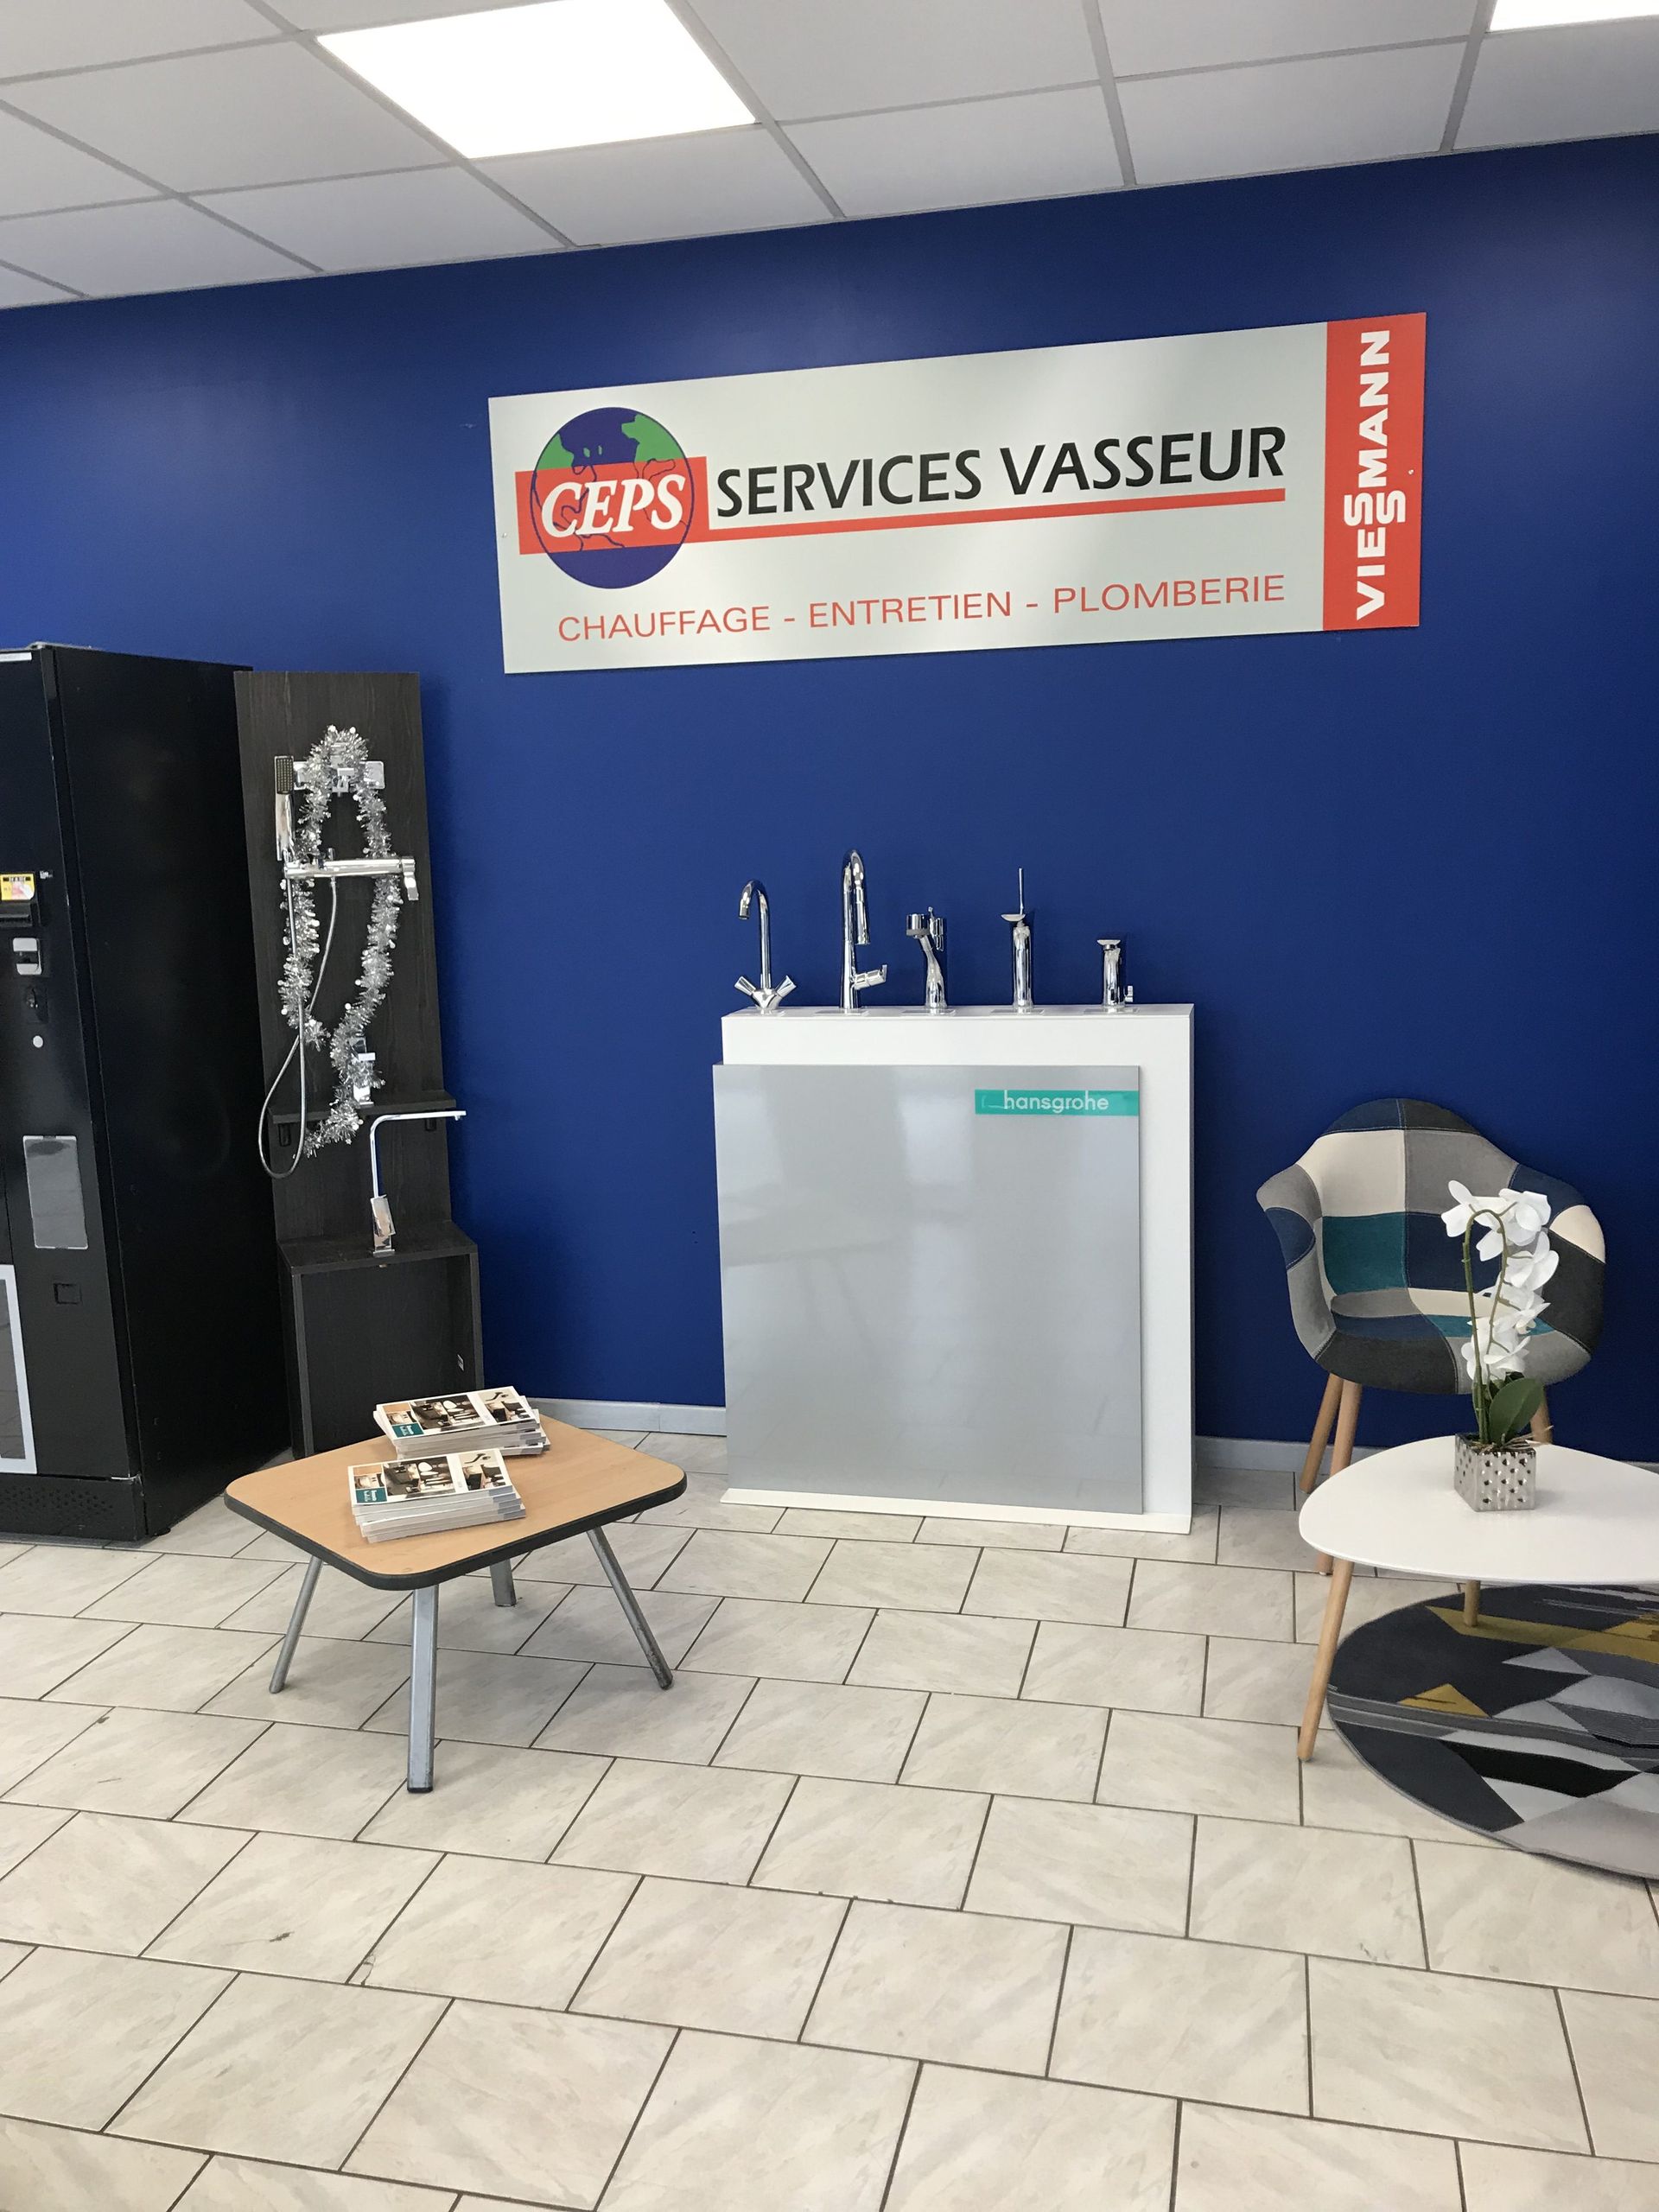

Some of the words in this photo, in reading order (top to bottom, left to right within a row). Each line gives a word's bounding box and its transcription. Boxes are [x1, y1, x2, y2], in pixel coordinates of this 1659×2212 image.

[541, 474, 686, 538] CEPS
[717, 449, 982, 518] SERVICES
[1000, 426, 1286, 495] VASSEUR
[1344, 330, 1406, 620] VIESSMANN
[558, 606, 769, 642] CHAUFFAGE
[809, 592, 1011, 628] ENTRETIEN
[1053, 574, 1283, 613] PLOMBERIE
[1004, 1090, 1109, 1114] hansgrohe
